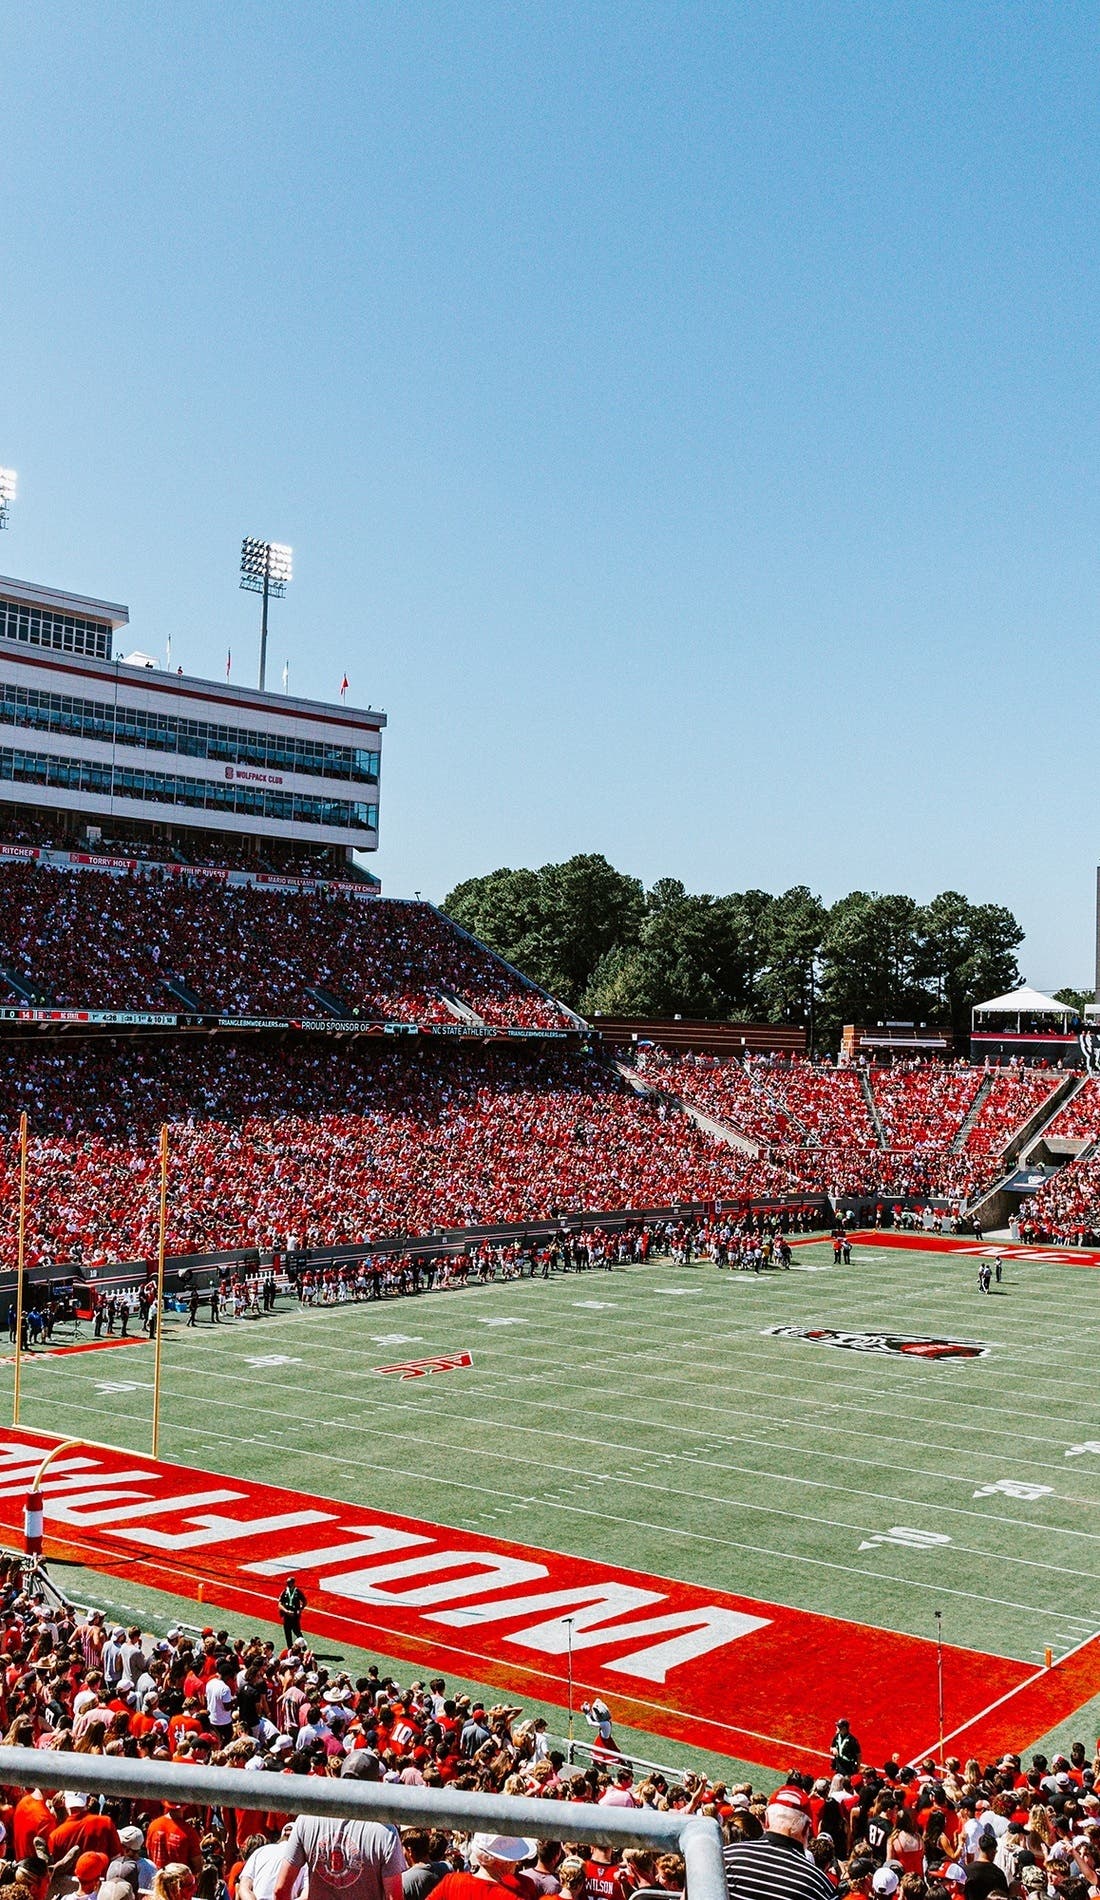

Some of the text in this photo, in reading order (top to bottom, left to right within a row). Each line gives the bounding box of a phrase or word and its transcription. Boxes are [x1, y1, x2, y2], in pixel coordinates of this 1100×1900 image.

[236, 771, 283, 784] WOLFPACK CLUB
[2, 846, 34, 857] RITCHER
[88, 857, 131, 868] TORRY HOLT
[301, 1021, 370, 1032] PROUD SPONSOR OF
[432, 1026, 497, 1037] NC STATE ATHLETICS
[949, 1246, 1093, 1261] NC
[371, 1351, 473, 1380] ACC
[981, 1479, 1055, 1500] 20
[869, 1526, 952, 1549] 10
[869, 1824, 885, 1847] 87
[585, 1878, 613, 1895] WILSON
